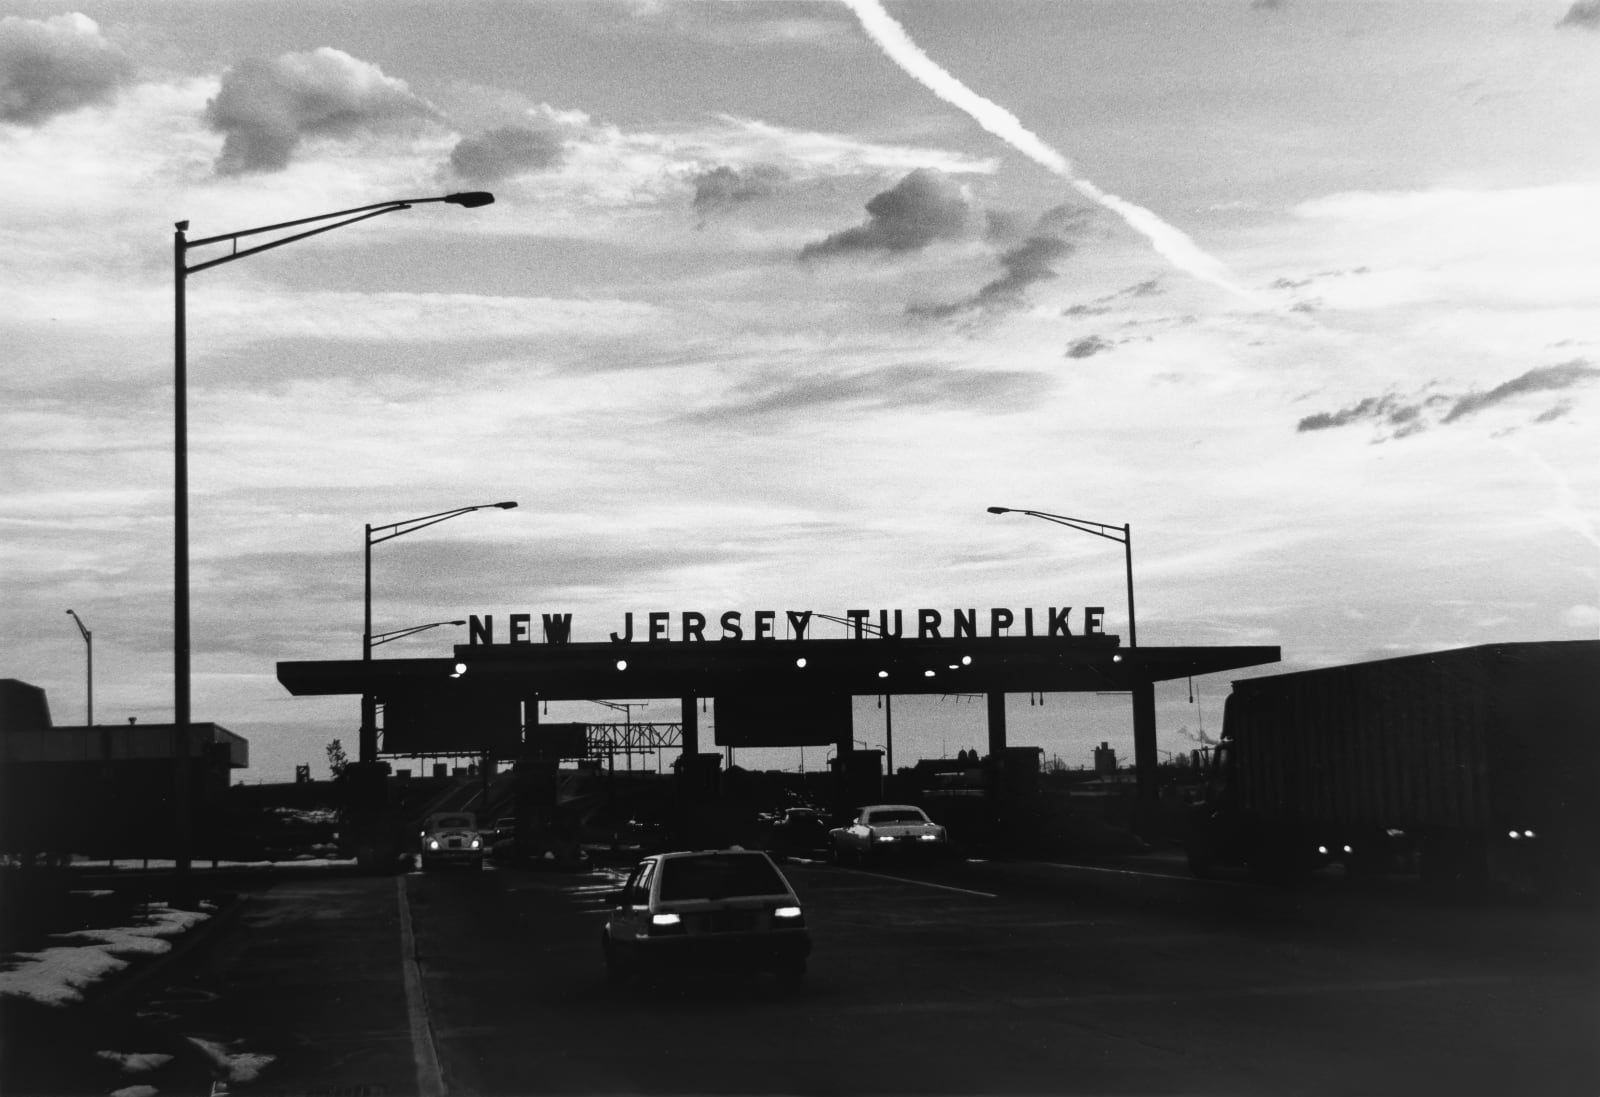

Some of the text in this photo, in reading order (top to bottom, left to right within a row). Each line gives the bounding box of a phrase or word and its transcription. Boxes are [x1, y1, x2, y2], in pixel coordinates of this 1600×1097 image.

[469, 607, 1105, 645] NEW JERSEY TURNPIKE
